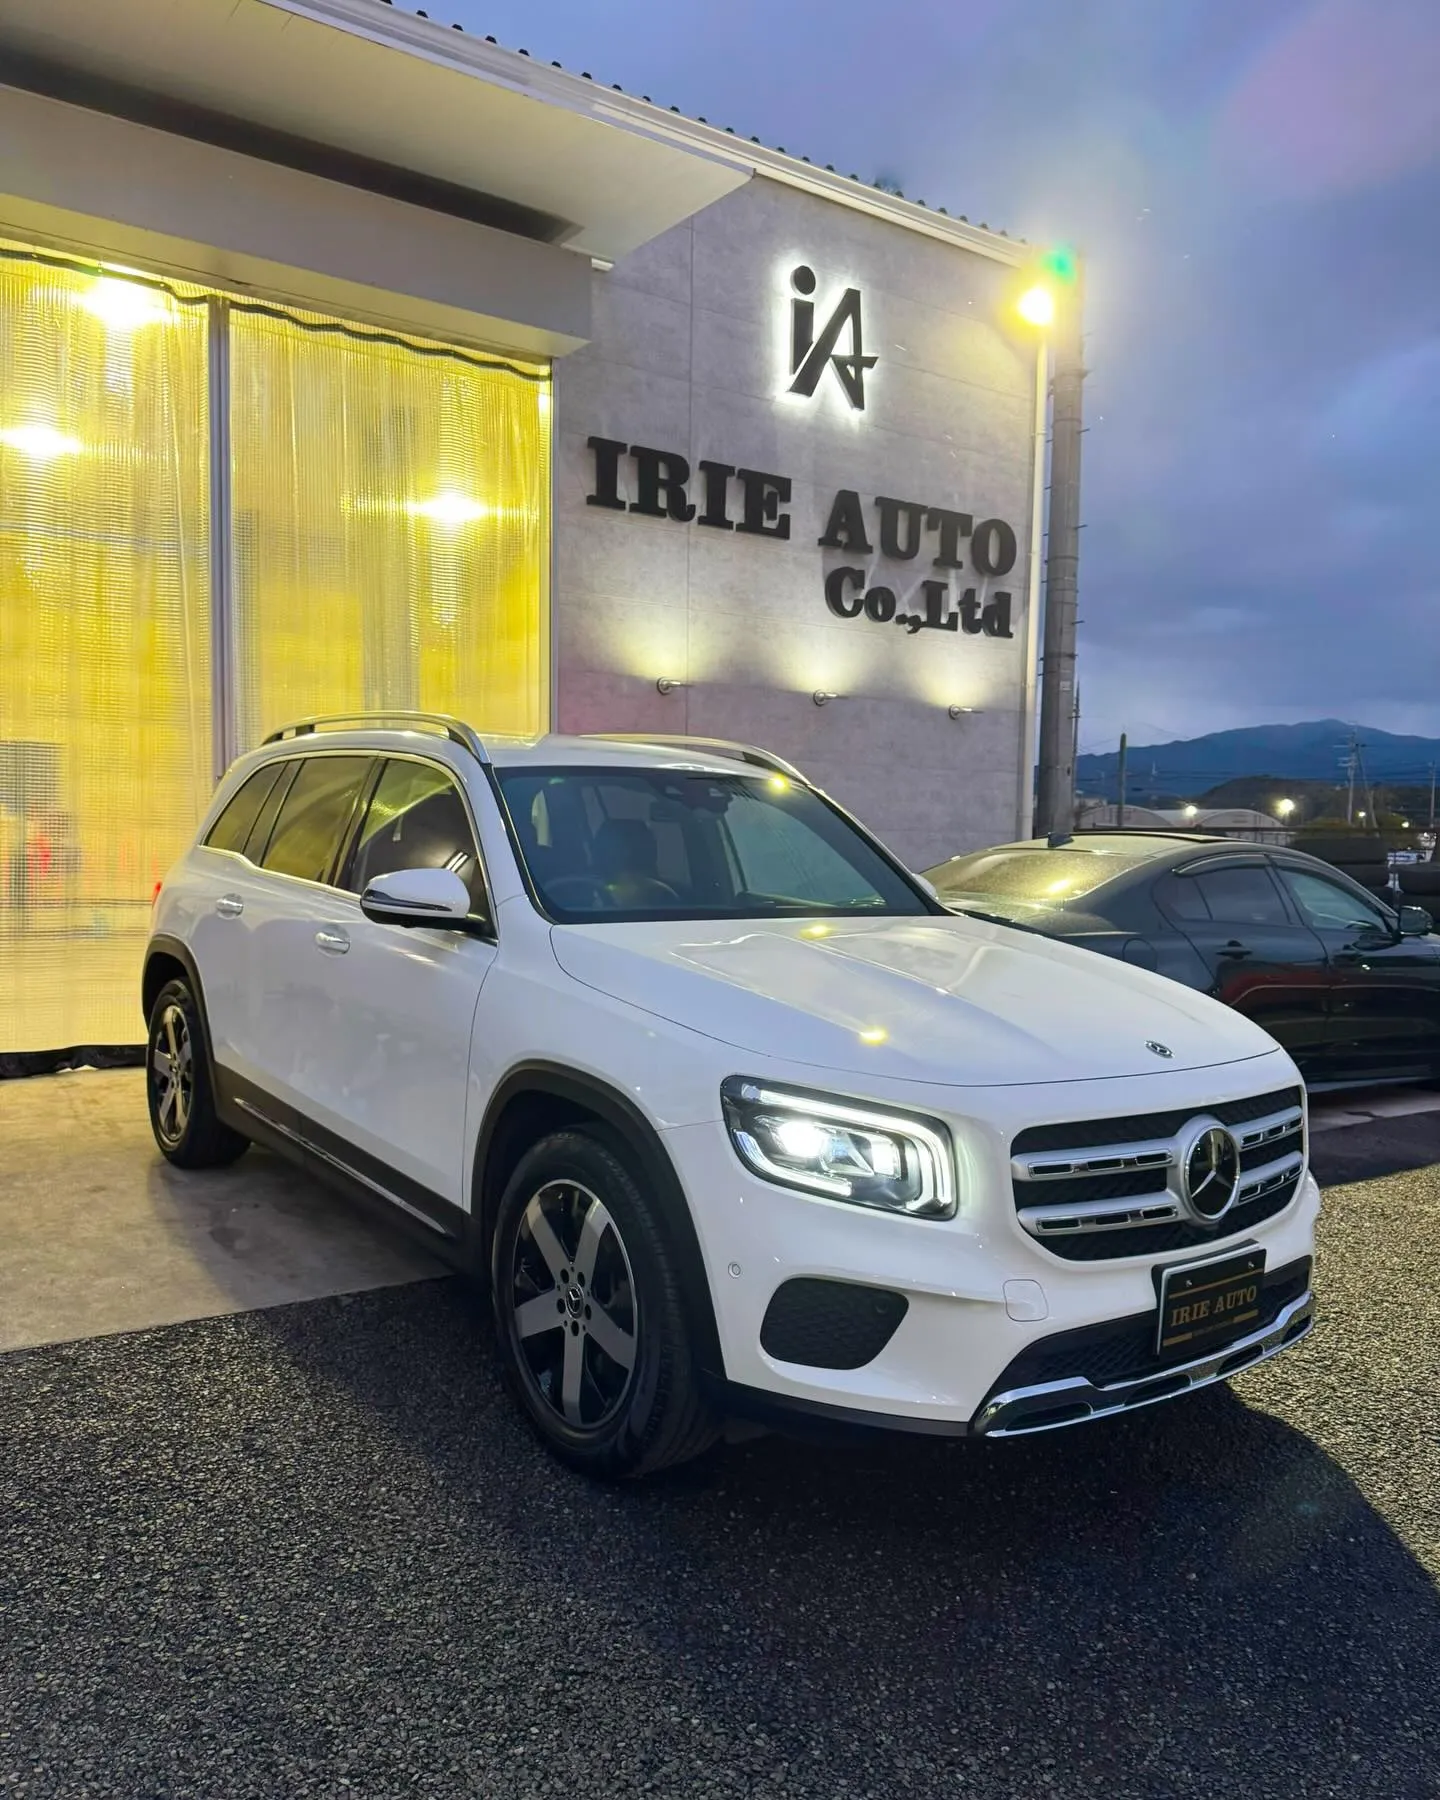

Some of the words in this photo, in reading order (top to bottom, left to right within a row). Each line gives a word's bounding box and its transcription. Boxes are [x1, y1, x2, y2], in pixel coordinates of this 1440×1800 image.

[586, 436, 792, 540] IRIE
[818, 489, 1017, 577] AUTO
[824, 566, 1014, 639] Co.,Ltd
[1171, 1301, 1210, 1327] IRIE
[1214, 1286, 1257, 1313] AUTO
